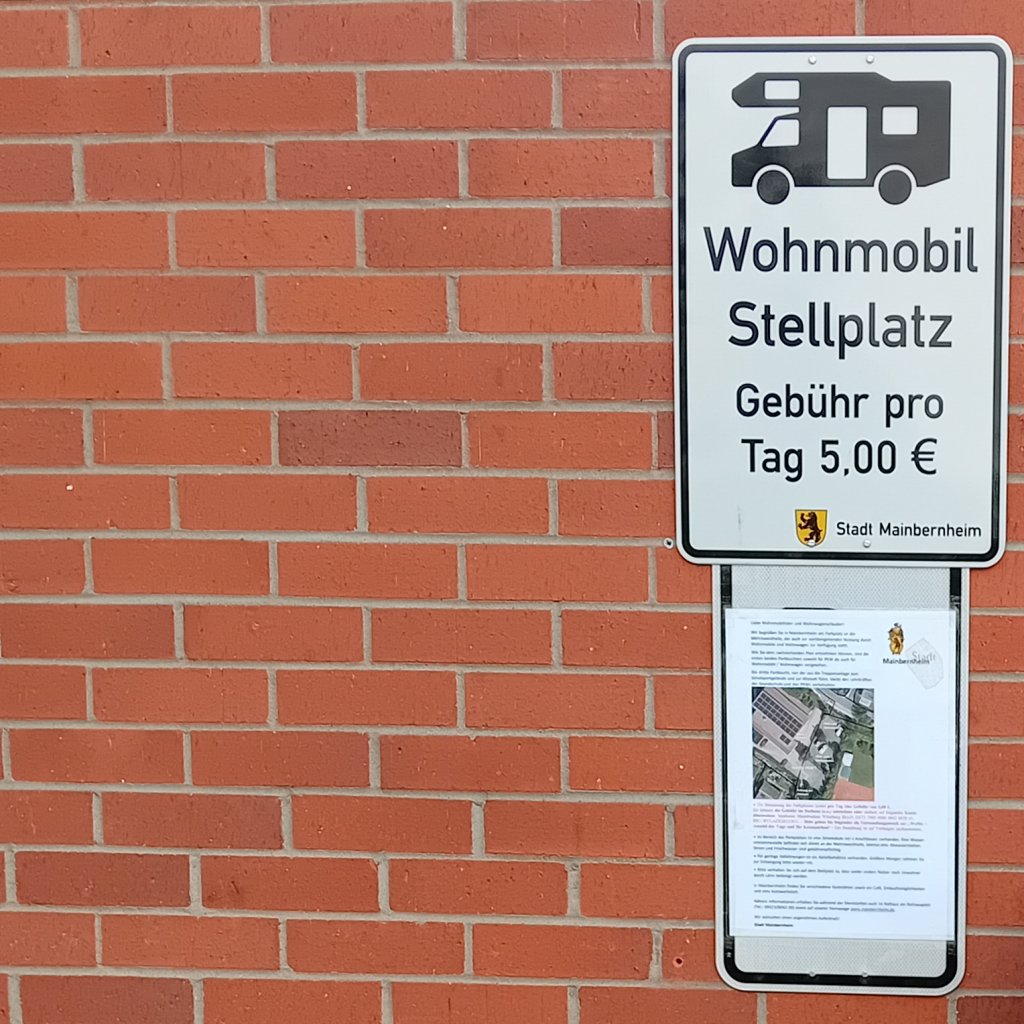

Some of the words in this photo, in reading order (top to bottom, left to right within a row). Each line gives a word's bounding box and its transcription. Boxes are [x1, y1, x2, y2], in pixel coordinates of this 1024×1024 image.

[704, 226, 978, 273] Wohnmobil
[728, 300, 953, 360] Stellplatz
[735, 383, 870, 418] Gebühr
[885, 393, 944, 428] pro
[741, 438, 803, 483] Tag
[820, 439, 897, 477] 5,00
[910, 437, 938, 476] €
[836, 521, 873, 536] Stadt
[879, 522, 982, 538] Mainbernheim
